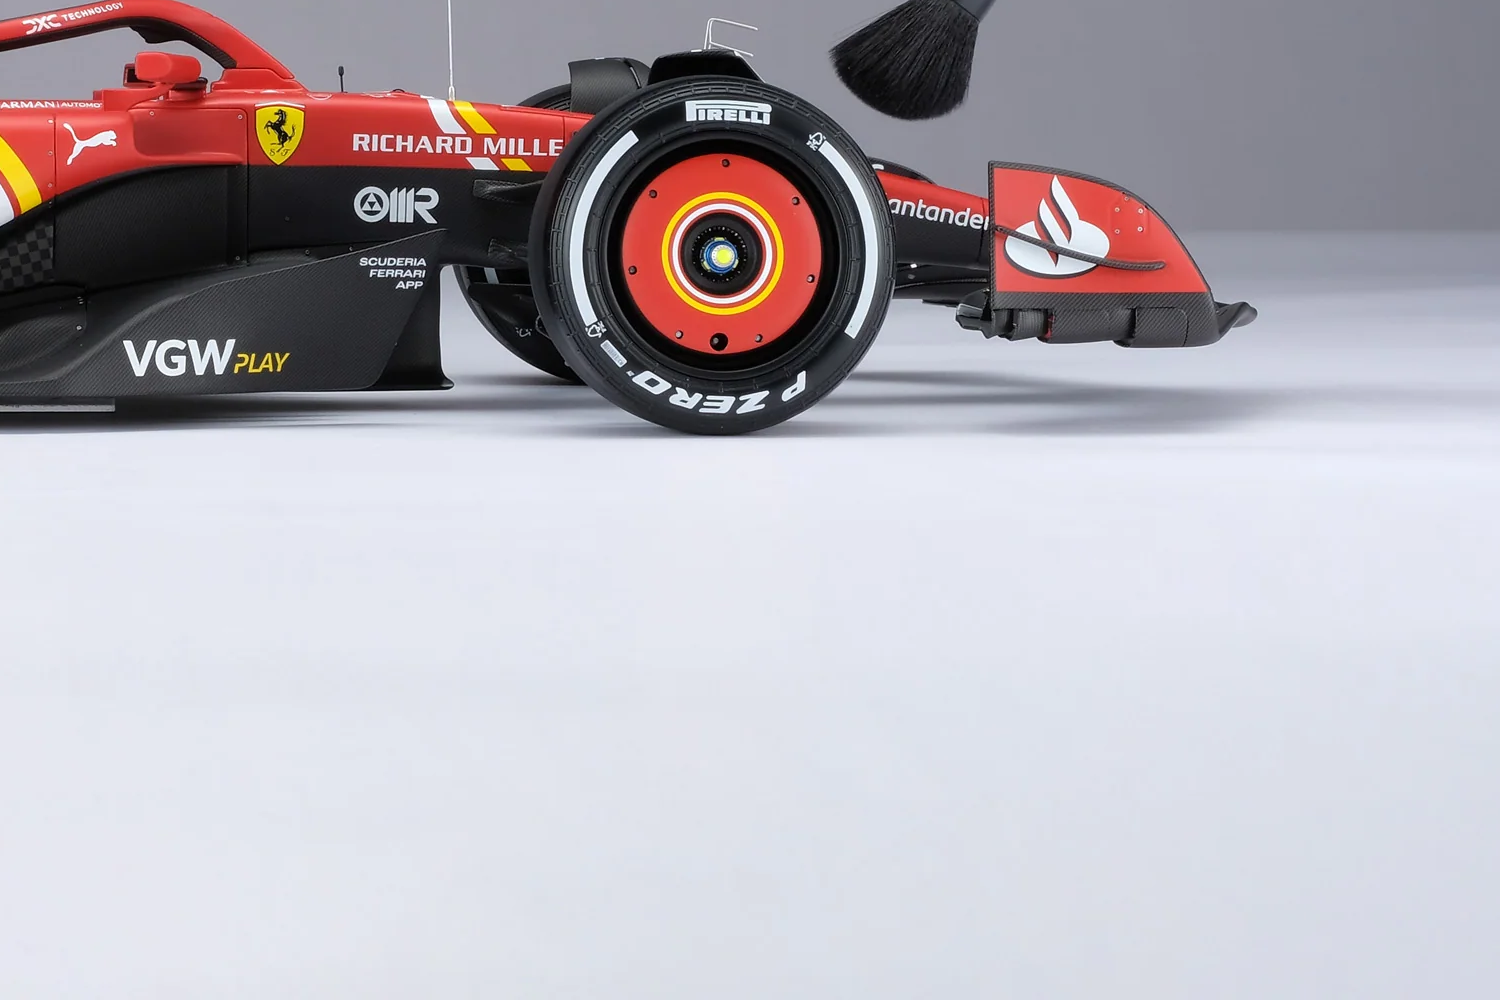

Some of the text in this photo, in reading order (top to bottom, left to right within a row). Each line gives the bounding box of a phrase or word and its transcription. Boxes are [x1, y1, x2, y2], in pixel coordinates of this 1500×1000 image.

[22, 2, 124, 35] DXC TECHNOLOGY
[685, 99, 772, 125] PIRELLI
[353, 133, 564, 157] RICHARD MILLE
[887, 198, 989, 231] antander
[359, 257, 427, 267] SCUDERIA
[369, 269, 426, 279] FERRARI
[395, 281, 424, 290] APP
[122, 338, 291, 377] VGW PLAY
[632, 370, 807, 414] P ZERO
